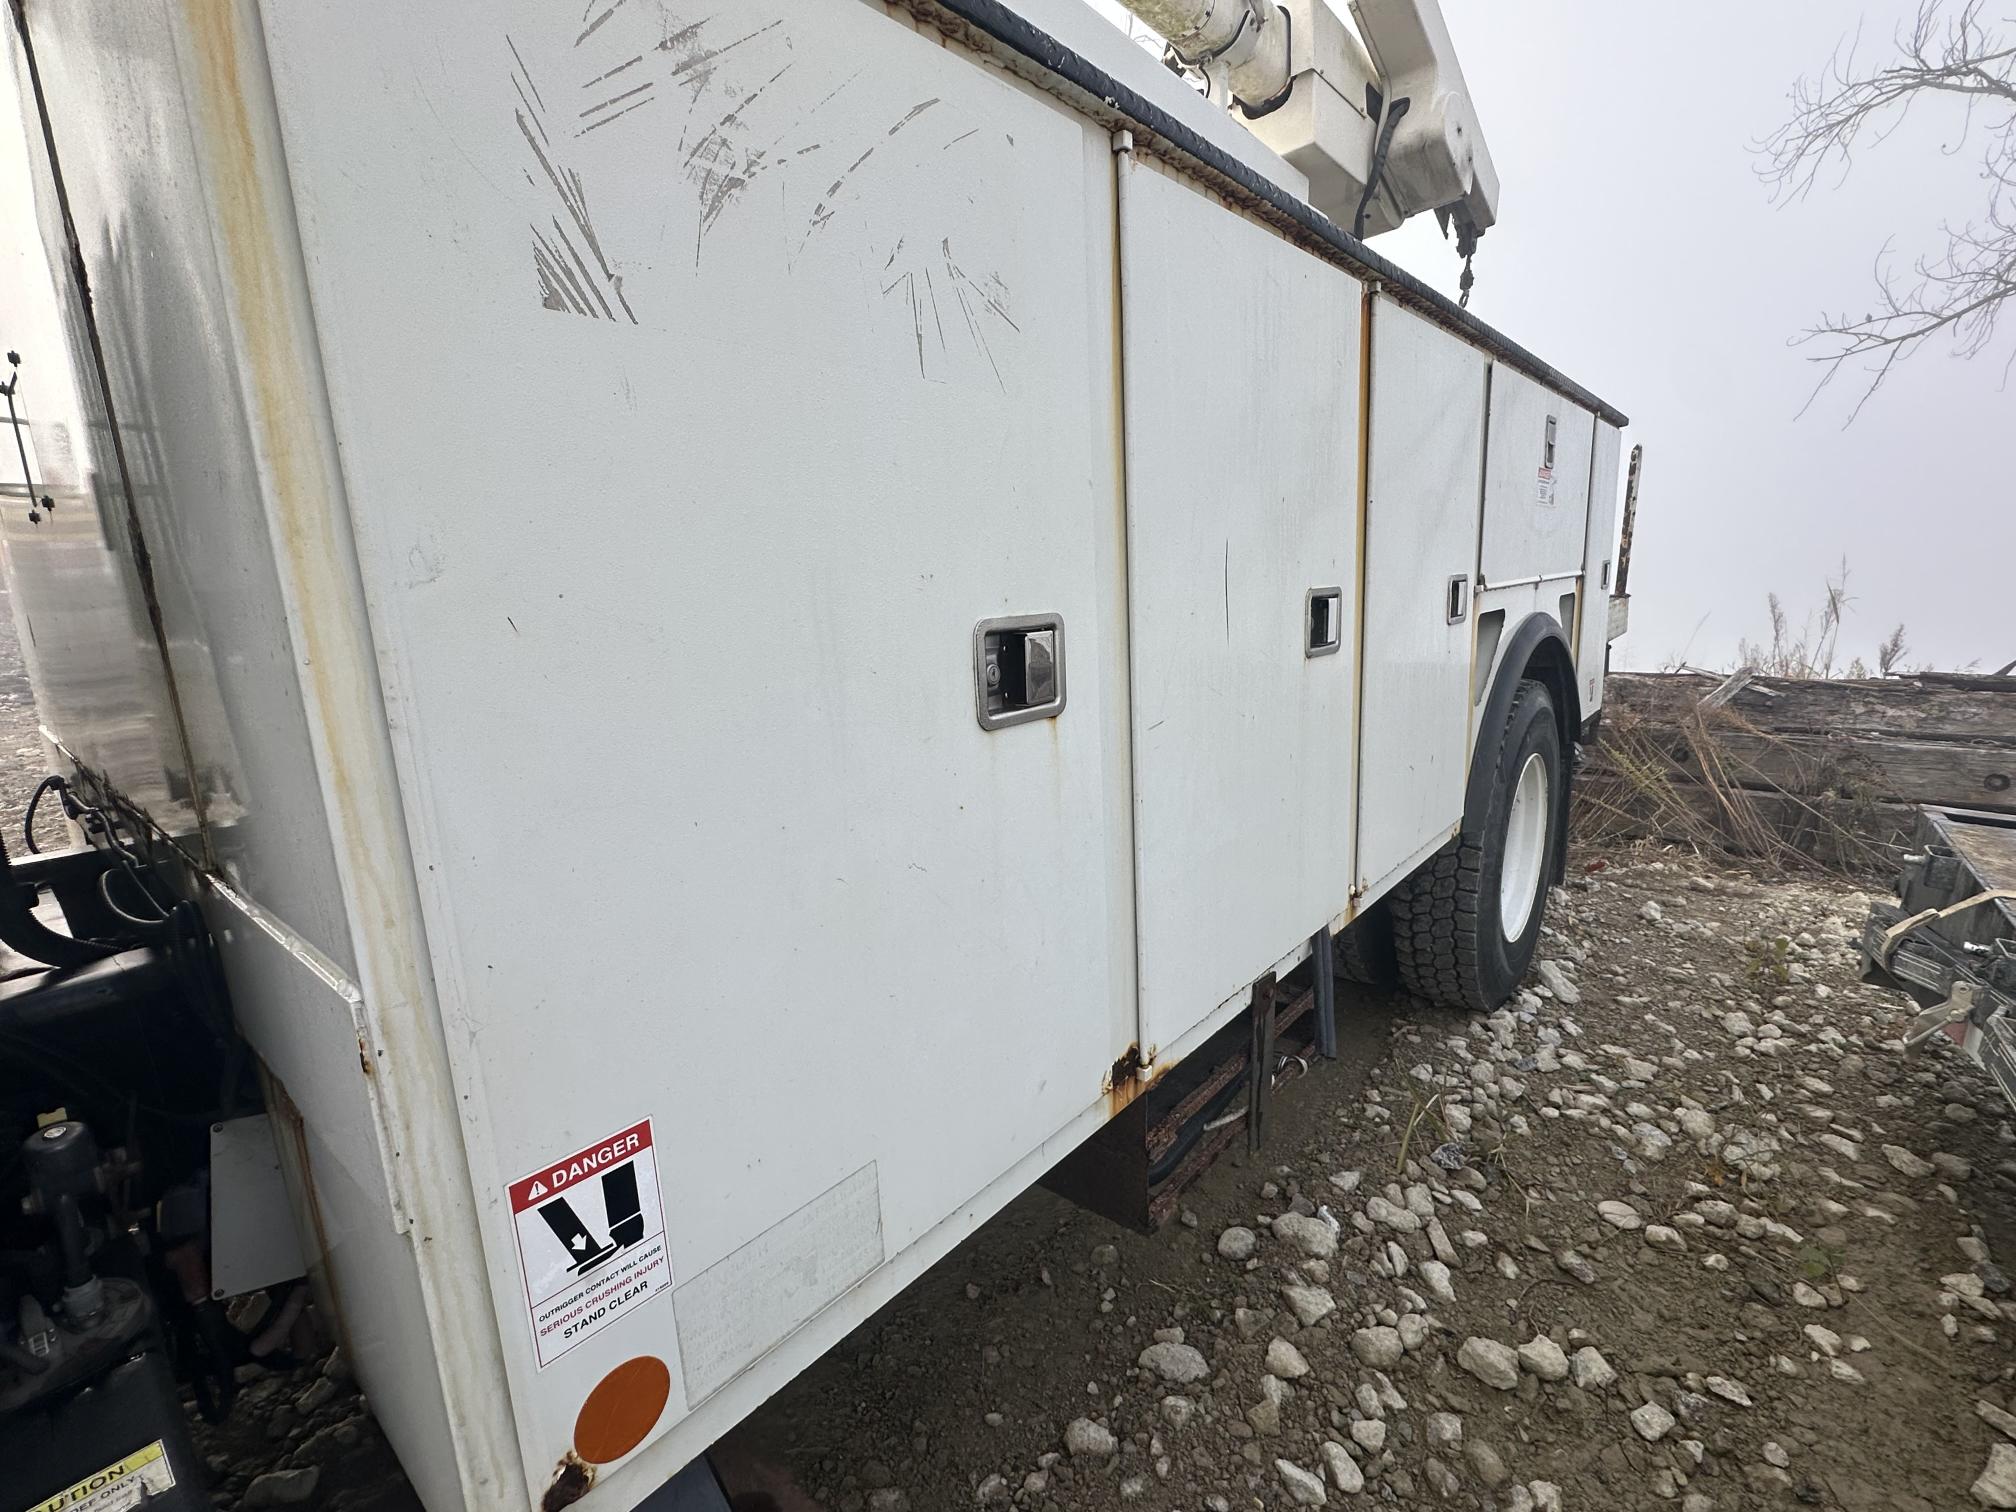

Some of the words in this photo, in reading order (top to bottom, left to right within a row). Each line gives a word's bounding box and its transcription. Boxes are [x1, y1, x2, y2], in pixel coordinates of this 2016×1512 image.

[551, 1133, 640, 1188] DANGER
[539, 1291, 584, 1322] OUTRIGGER
[585, 1270, 619, 1295] CONTACT
[620, 1260, 638, 1273] WILL
[638, 1245, 662, 1263] CAUSE
[540, 1306, 584, 1337] SERIOUS
[585, 1275, 632, 1309] CRUSHING
[634, 1256, 665, 1280] INJURY
[563, 1307, 606, 1339] STAND
[609, 1280, 648, 1310] CLEAR
[35, 1465, 125, 1512] UTION
